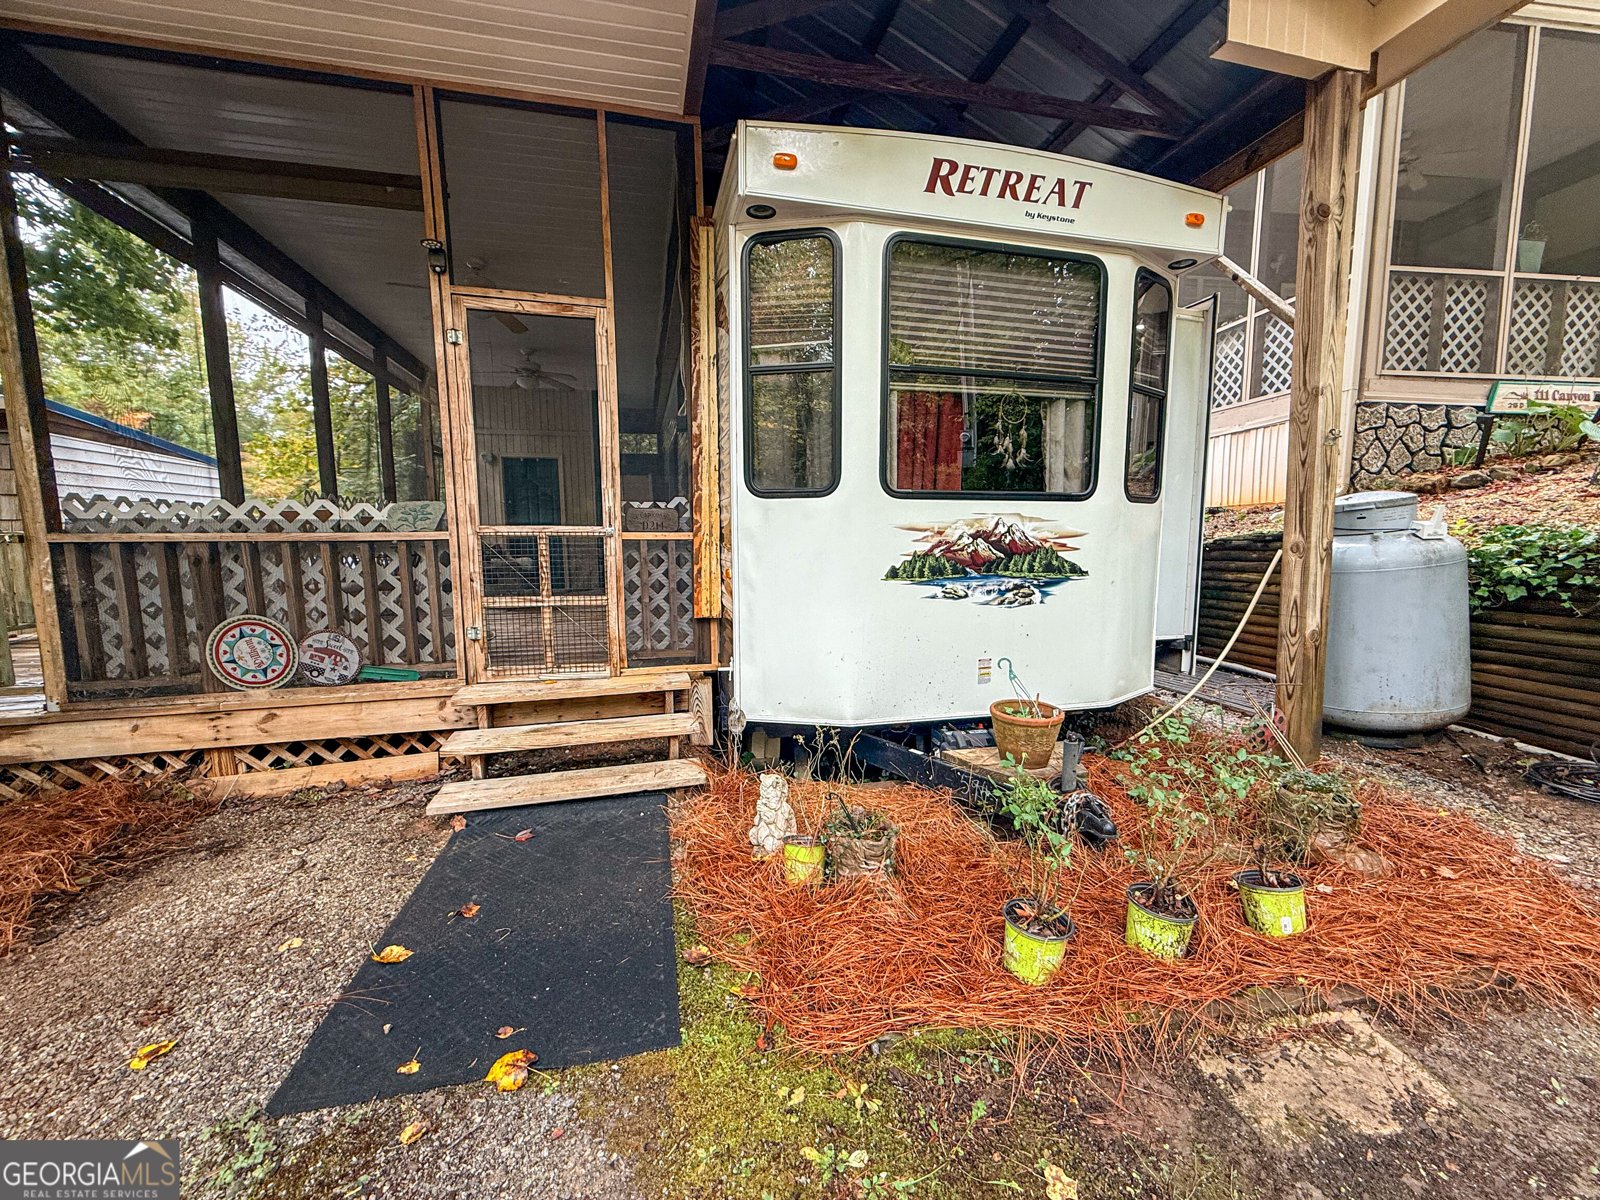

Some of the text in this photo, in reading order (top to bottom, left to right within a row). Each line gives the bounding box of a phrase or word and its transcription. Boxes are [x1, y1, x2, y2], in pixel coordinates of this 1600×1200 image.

[923, 157, 1093, 209] RETREAT
[1024, 210, 1076, 225] by Keystone
[1551, 389, 1591, 404] Canyon
